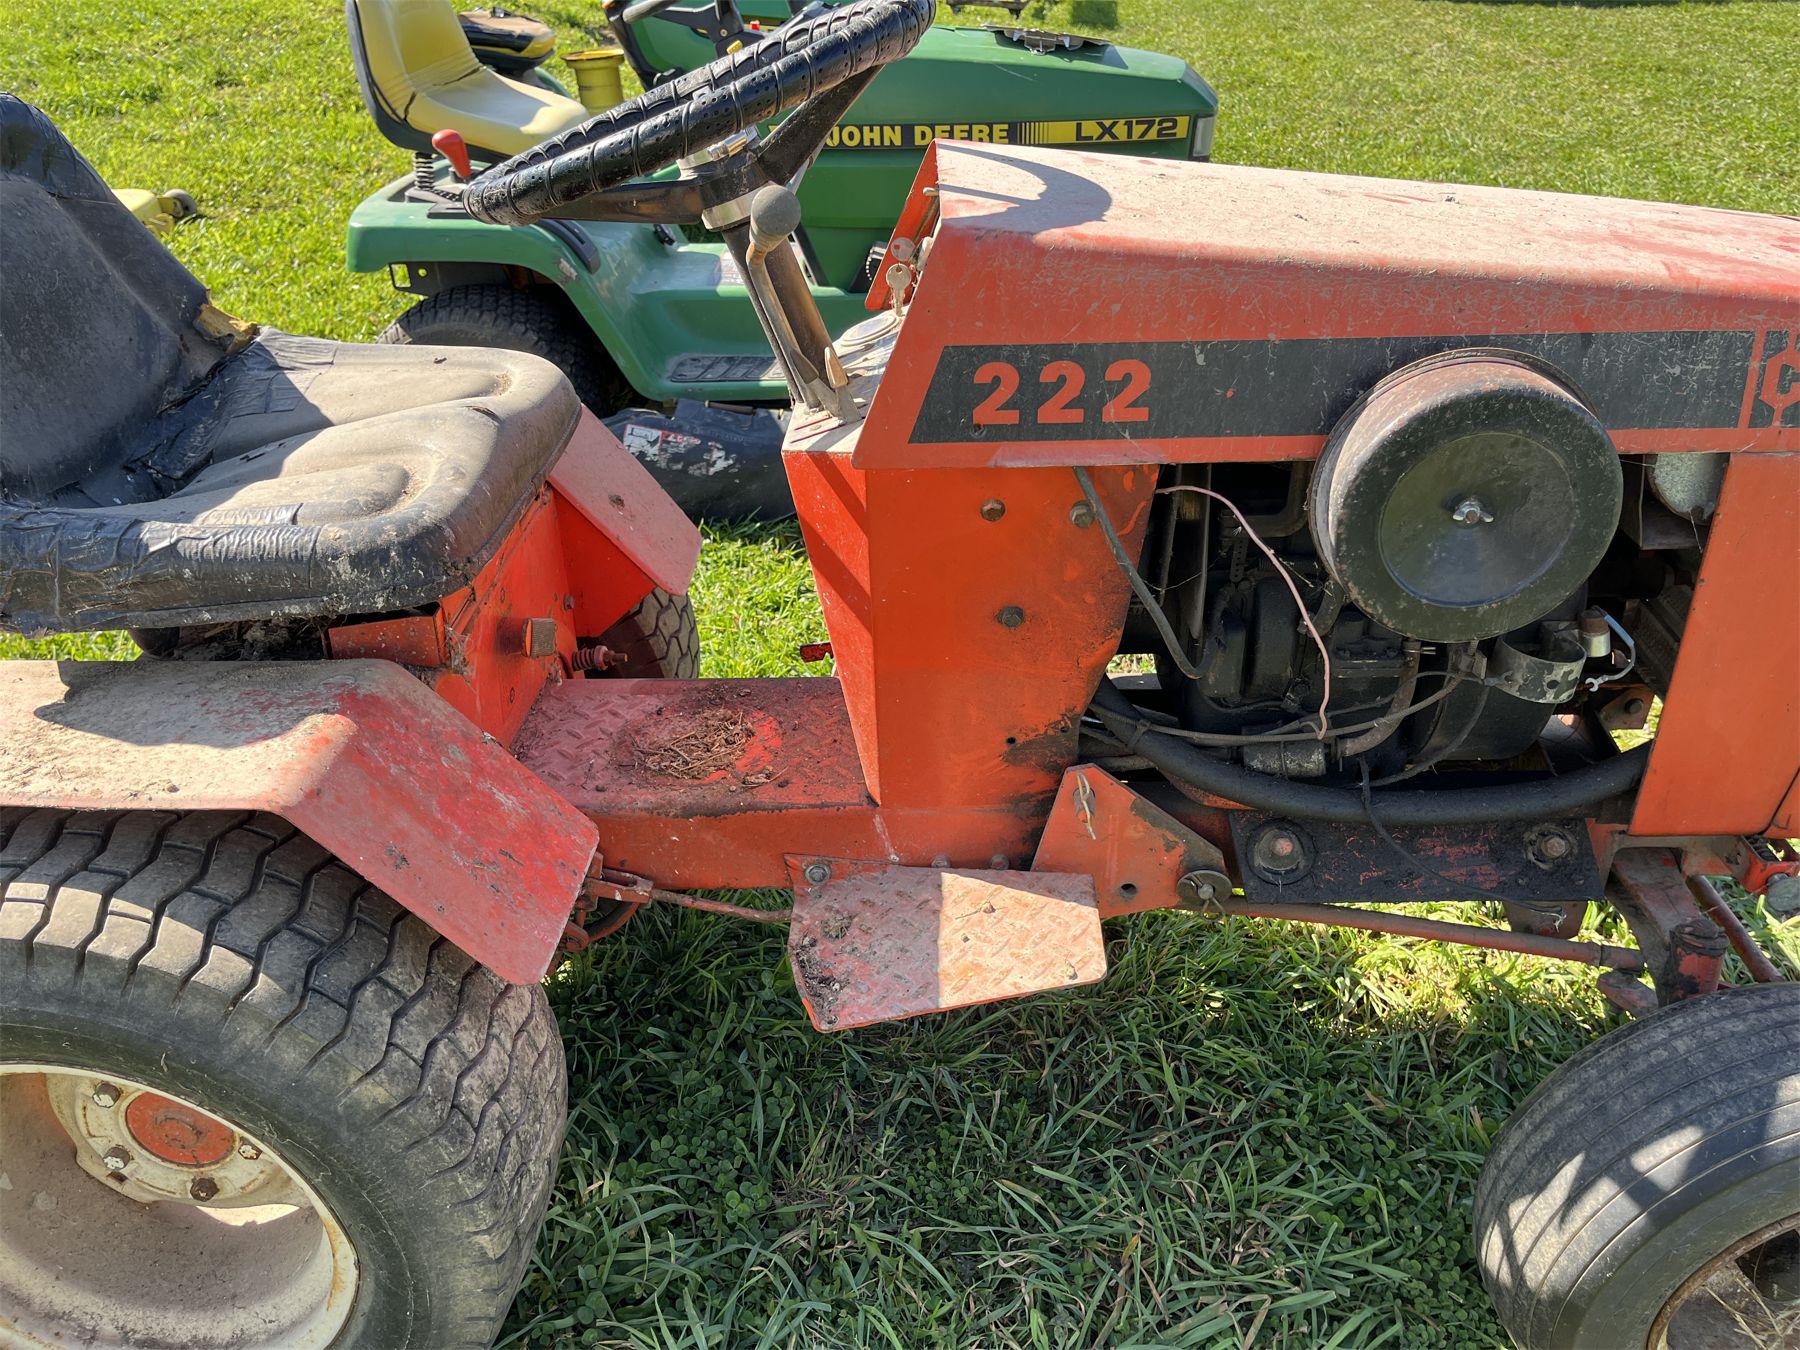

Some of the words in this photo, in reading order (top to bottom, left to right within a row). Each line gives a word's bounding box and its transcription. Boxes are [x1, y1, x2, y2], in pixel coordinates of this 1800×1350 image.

[825, 125, 901, 147] JOHN
[914, 124, 1009, 146] DEERE
[1076, 118, 1178, 141] LX172
[972, 359, 1152, 425] 222
